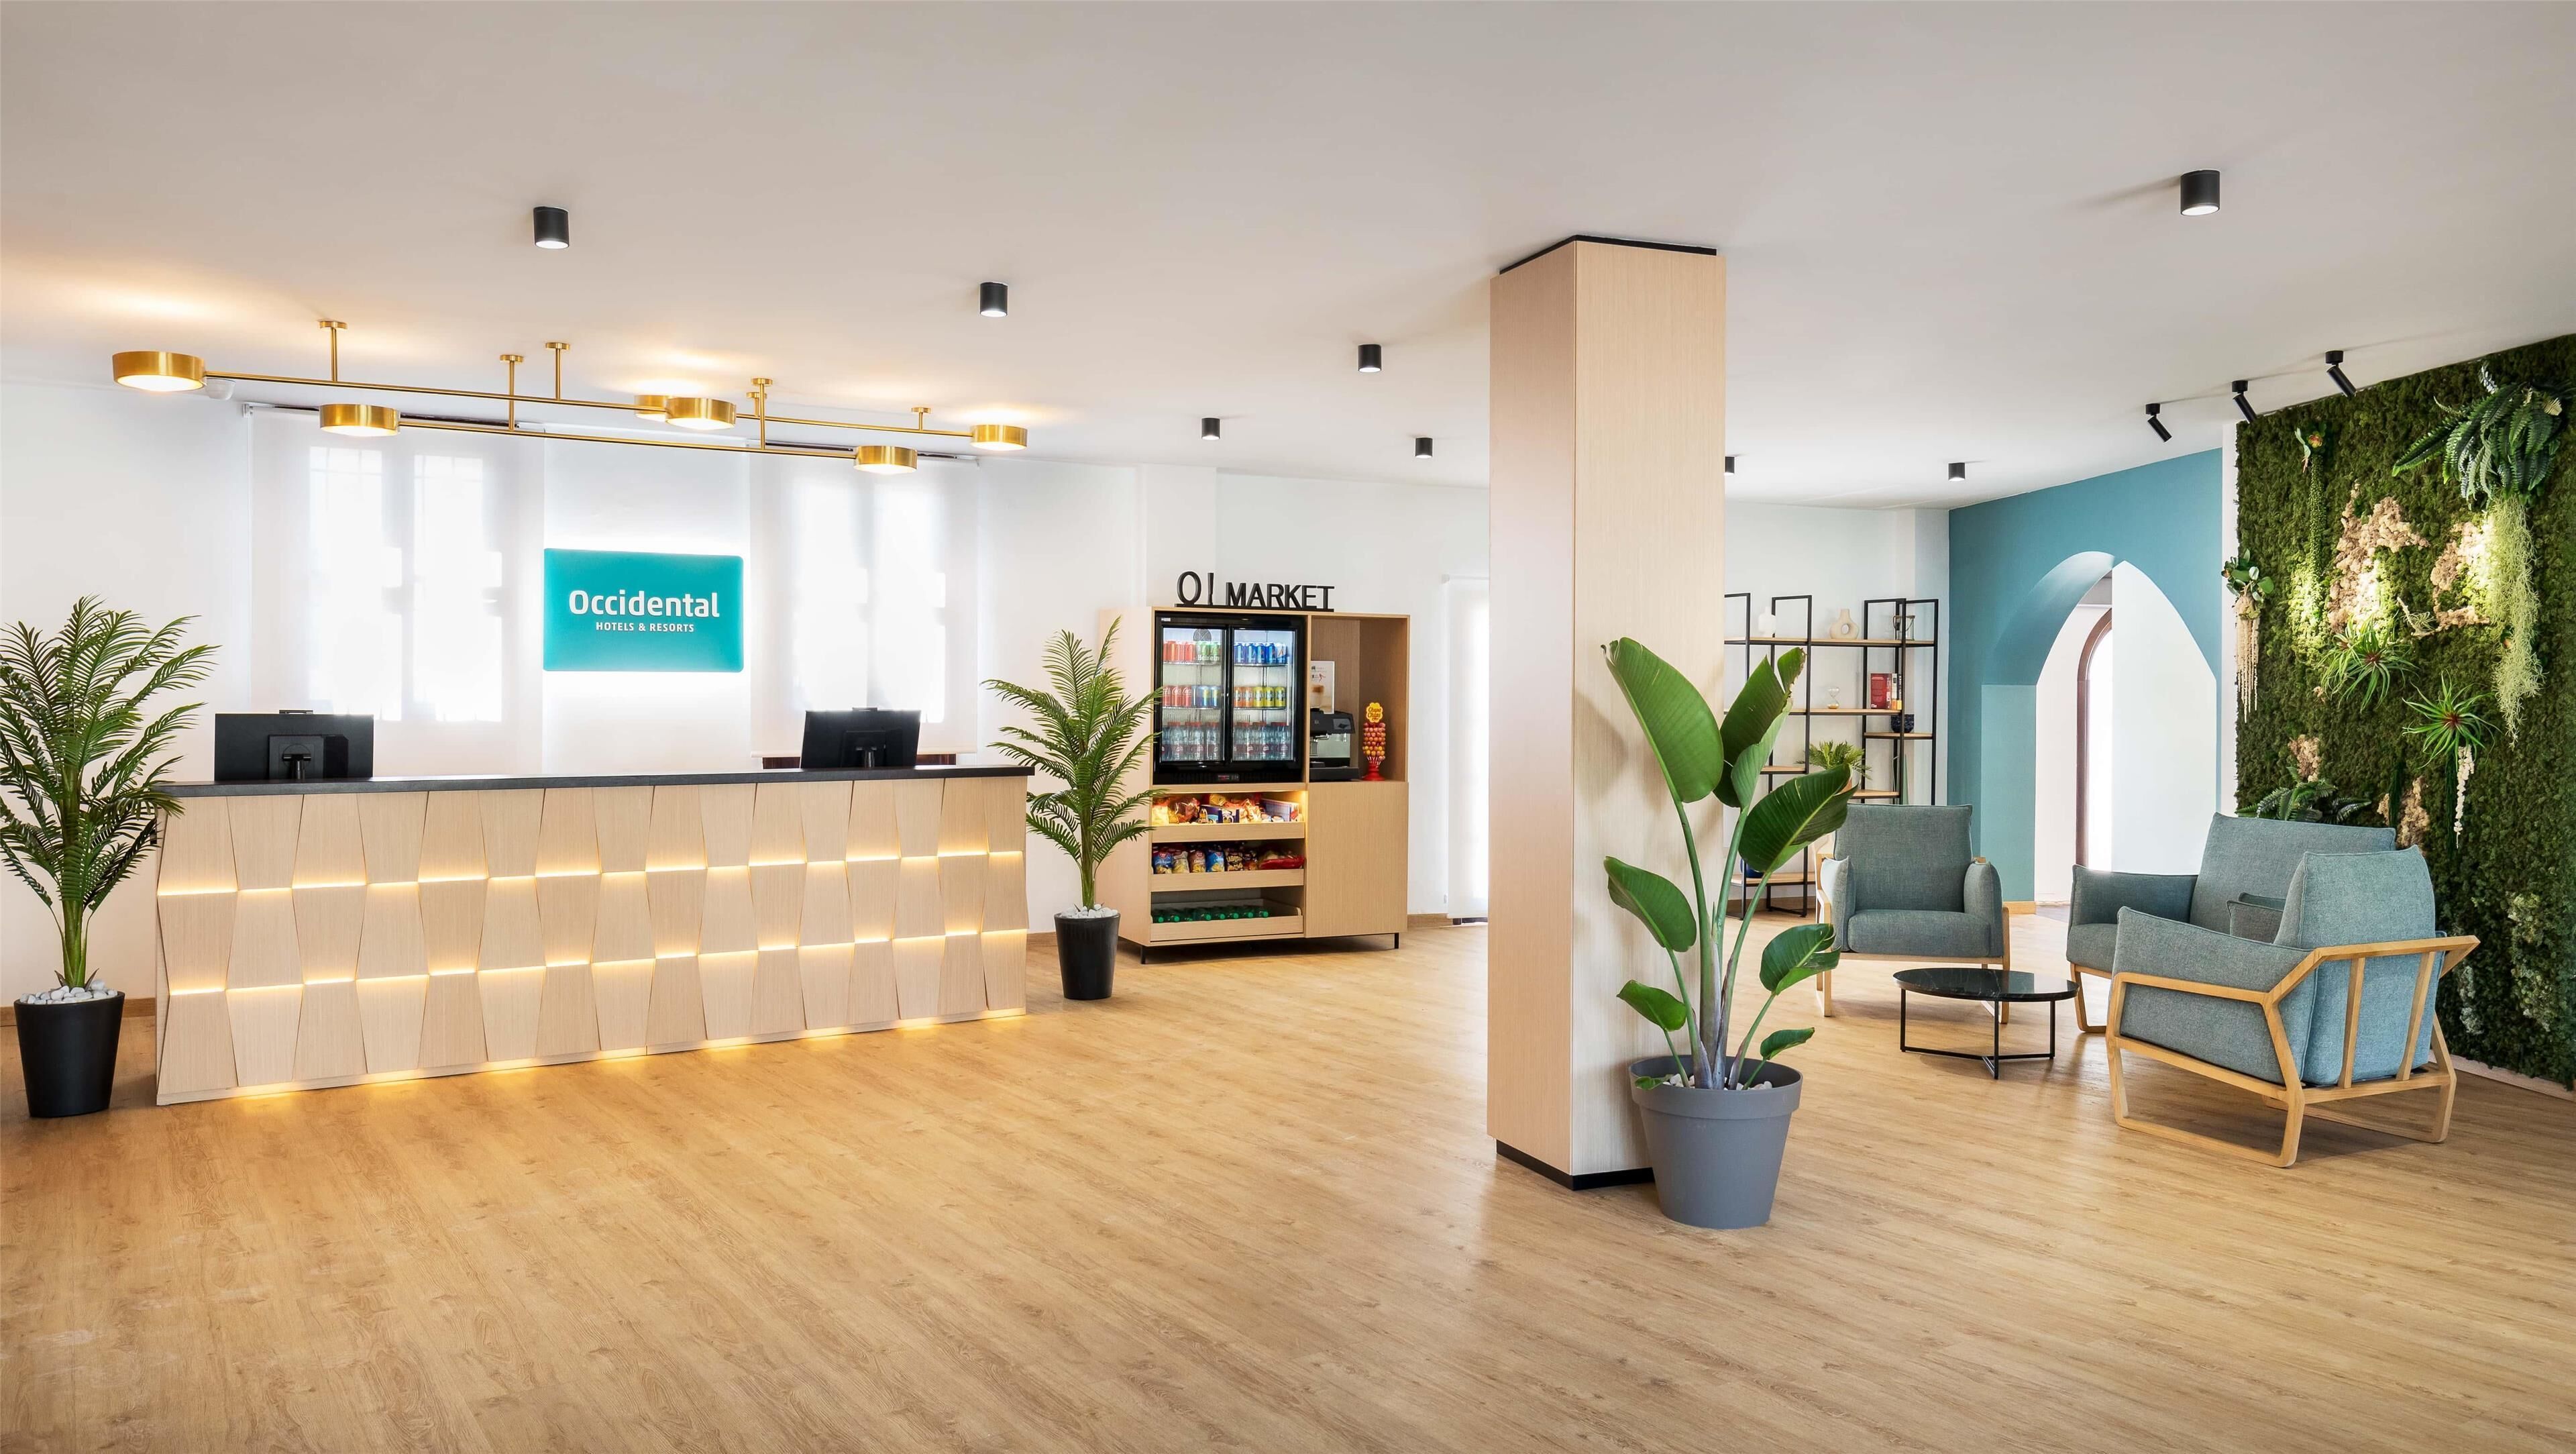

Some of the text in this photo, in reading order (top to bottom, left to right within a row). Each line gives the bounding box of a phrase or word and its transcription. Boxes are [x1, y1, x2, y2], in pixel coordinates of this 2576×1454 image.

[569, 589, 720, 617] Occidental
[1226, 582, 1335, 609] MARKET
[596, 622, 694, 632] HOTELS & RESORTS
